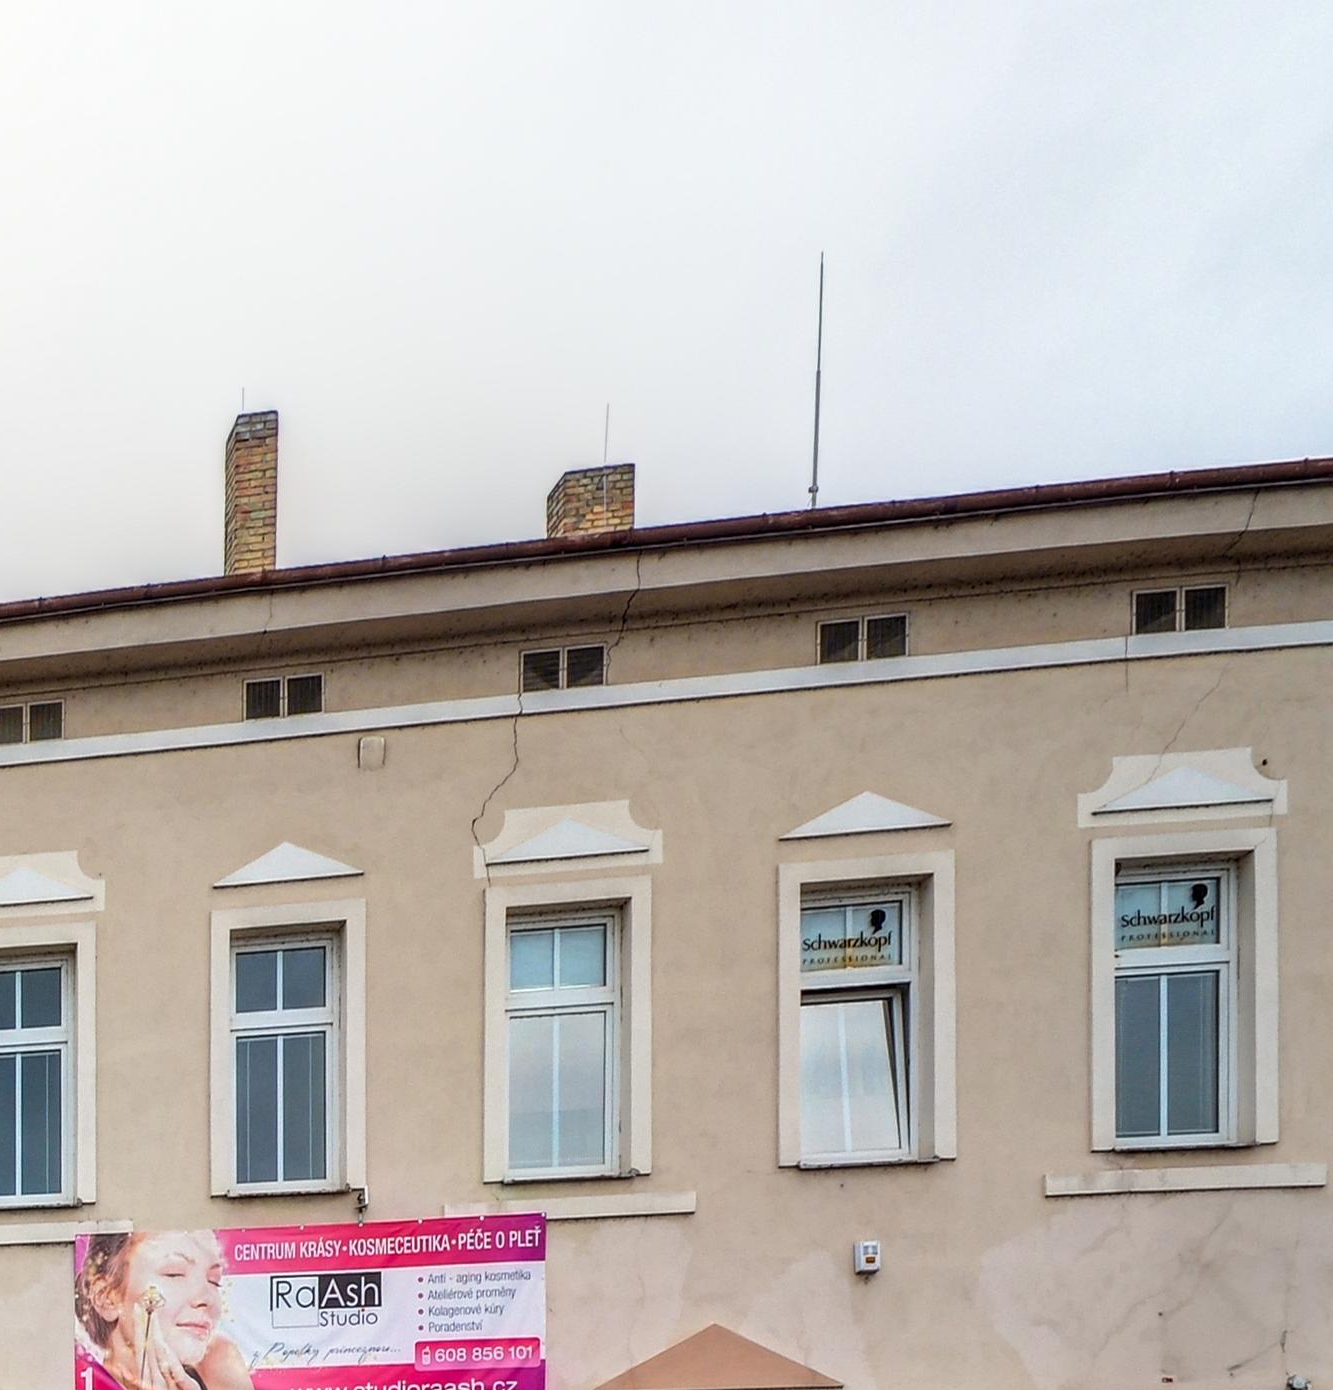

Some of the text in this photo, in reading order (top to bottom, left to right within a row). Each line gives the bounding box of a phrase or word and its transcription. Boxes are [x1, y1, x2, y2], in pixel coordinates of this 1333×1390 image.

[1121, 905, 1215, 928] Schwarzkopf
[802, 930, 893, 952] Schwarzkopf
[234, 1227, 542, 1261] CENTRUM KRÁSY KOSMECEUTIKA PÉČE O PLEŤ
[456, 1271, 482, 1285] aging
[484, 1270, 531, 1281] kosmetika
[276, 1275, 379, 1309] RaAsh
[427, 1287, 517, 1300] Ateliérové proměny
[319, 1308, 378, 1328] Studio
[428, 1303, 481, 1318] Kolagenové
[428, 1320, 483, 1332] Poradenství
[435, 1345, 534, 1362] 608 856 101
